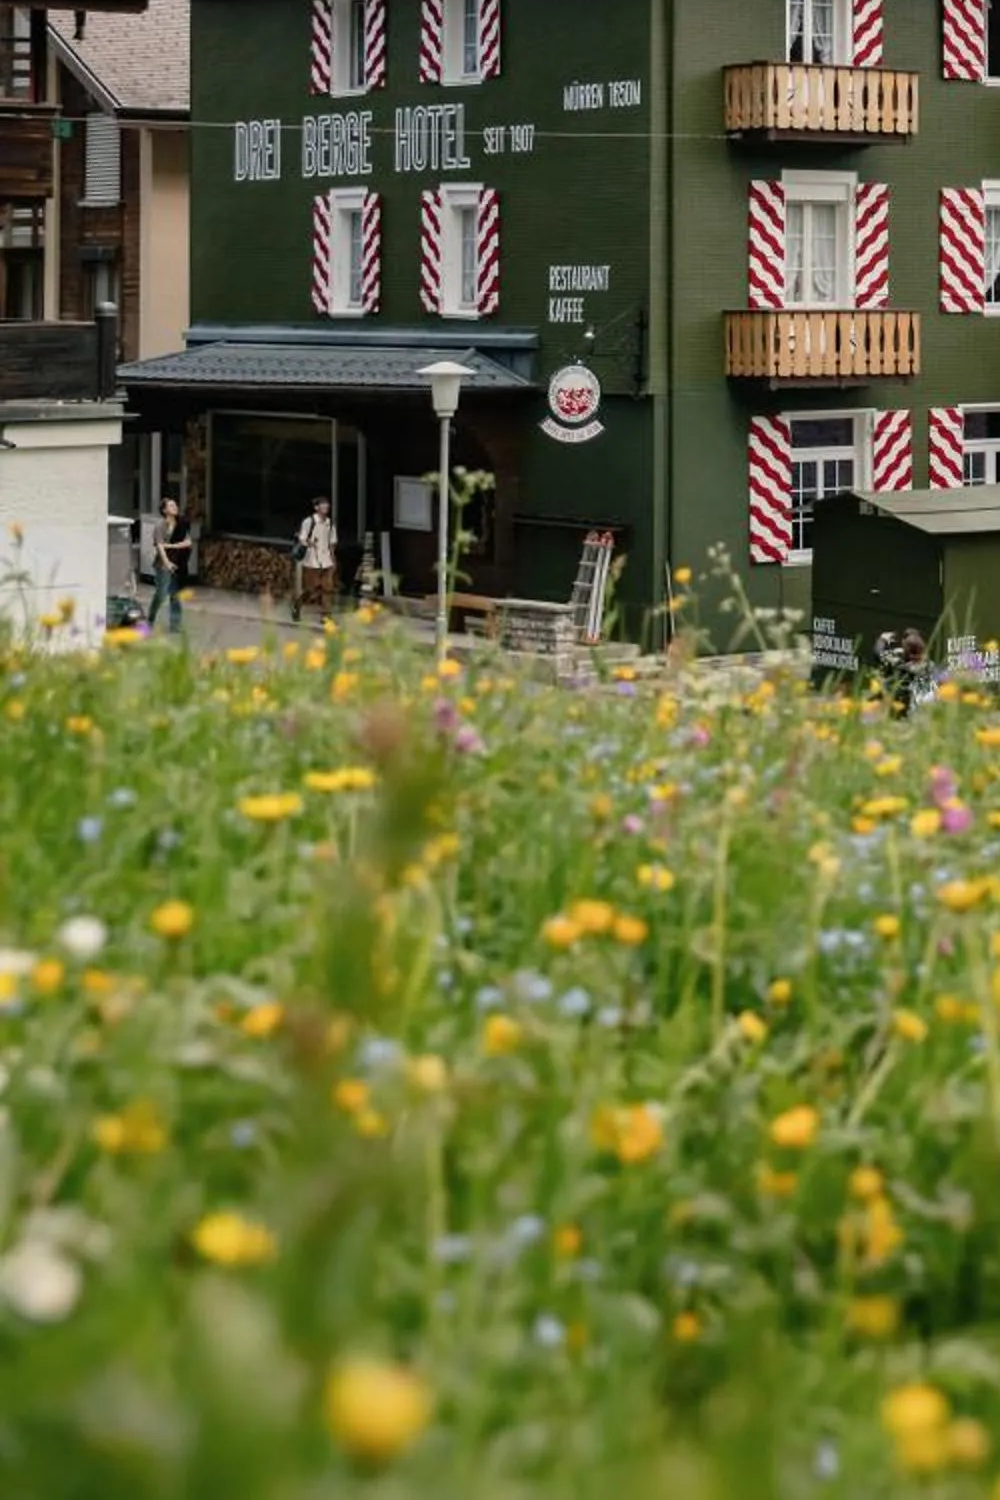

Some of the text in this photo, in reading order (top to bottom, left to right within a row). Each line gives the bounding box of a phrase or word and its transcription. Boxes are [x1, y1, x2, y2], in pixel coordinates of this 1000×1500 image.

[563, 80, 603, 111] MÜRREN
[235, 103, 470, 180] DREI BERGE HOTEL
[483, 124, 534, 154] SEIT 1907
[549, 265, 611, 291] RESTAURANT
[549, 298, 585, 323] KAFFEE
